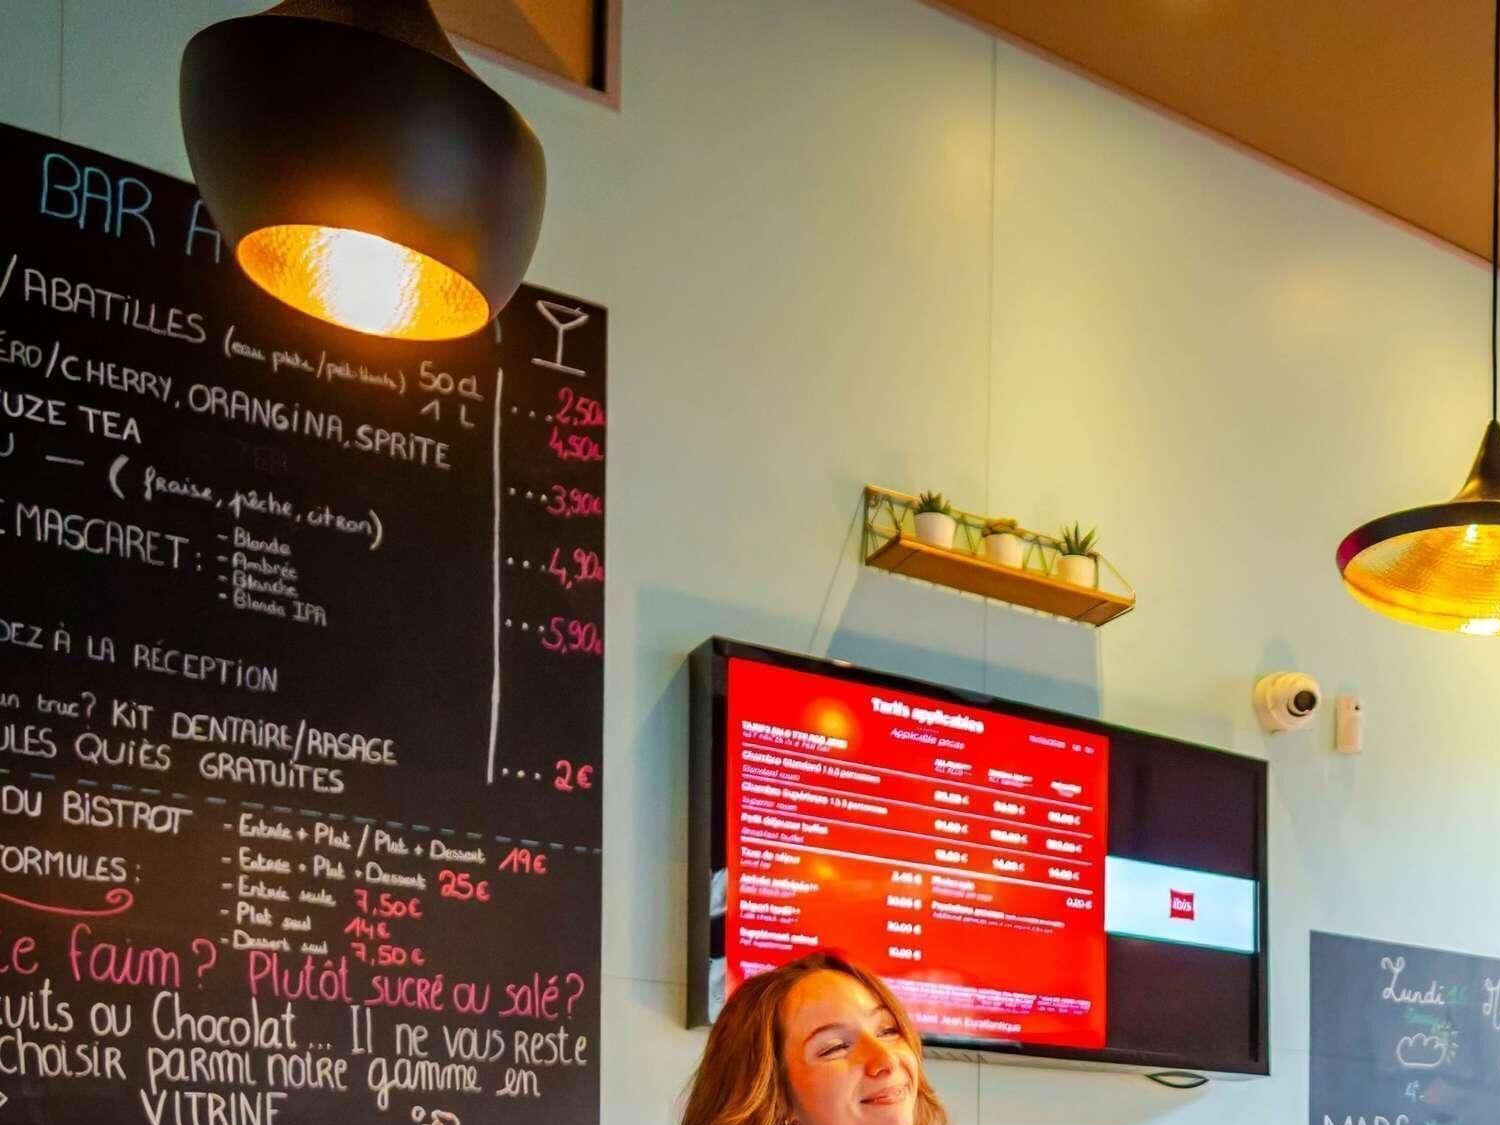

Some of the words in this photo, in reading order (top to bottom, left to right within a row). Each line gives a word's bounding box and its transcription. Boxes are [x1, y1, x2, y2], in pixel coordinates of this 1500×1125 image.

[40, 152, 155, 248] BAR
[0, 388, 67, 426] UZE
[78, 404, 142, 445] TEA
[86, 634, 117, 664] LA
[0, 783, 44, 818] DU
[553, 758, 595, 793] 2€
[312, 820, 352, 850] Plat
[372, 829, 410, 854] Plat
[311, 853, 347, 881] Plat
[436, 868, 493, 904] 25€
[235, 900, 274, 928] Plat
[67, 921, 182, 988] faim
[248, 950, 352, 1002] Plutôt
[452, 982, 493, 1014] ou
[1380, 956, 1446, 1005] Lundi
[0, 977, 75, 1034] uits
[89, 1000, 133, 1038] ou
[394, 1022, 430, 1058] ne
[442, 1024, 506, 1062] vous
[366, 1056, 483, 1111] gamme
[495, 1066, 542, 1099] en
